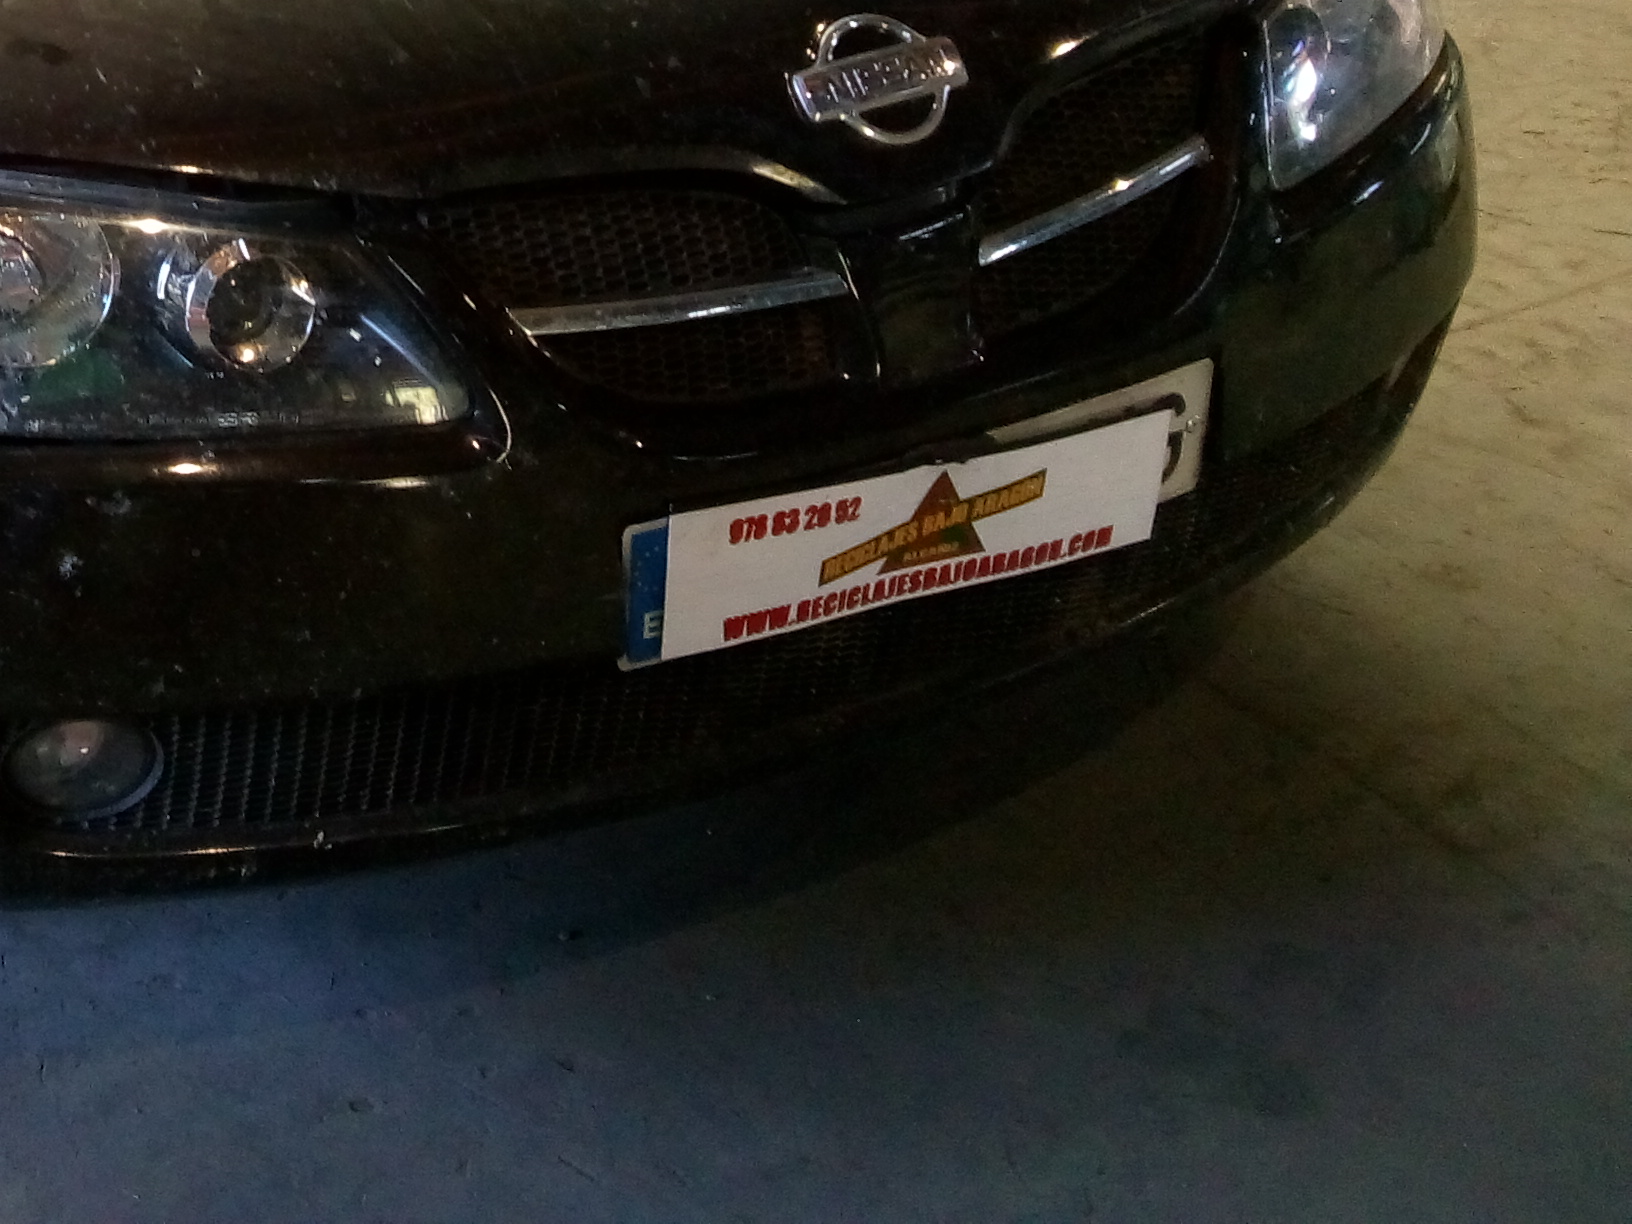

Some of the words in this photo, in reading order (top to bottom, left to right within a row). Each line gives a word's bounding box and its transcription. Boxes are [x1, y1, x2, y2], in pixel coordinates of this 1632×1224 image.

[729, 513, 768, 545] 978
[822, 523, 918, 581] RECICLAJES
[921, 502, 969, 536] BAJO
[642, 609, 663, 640] E
